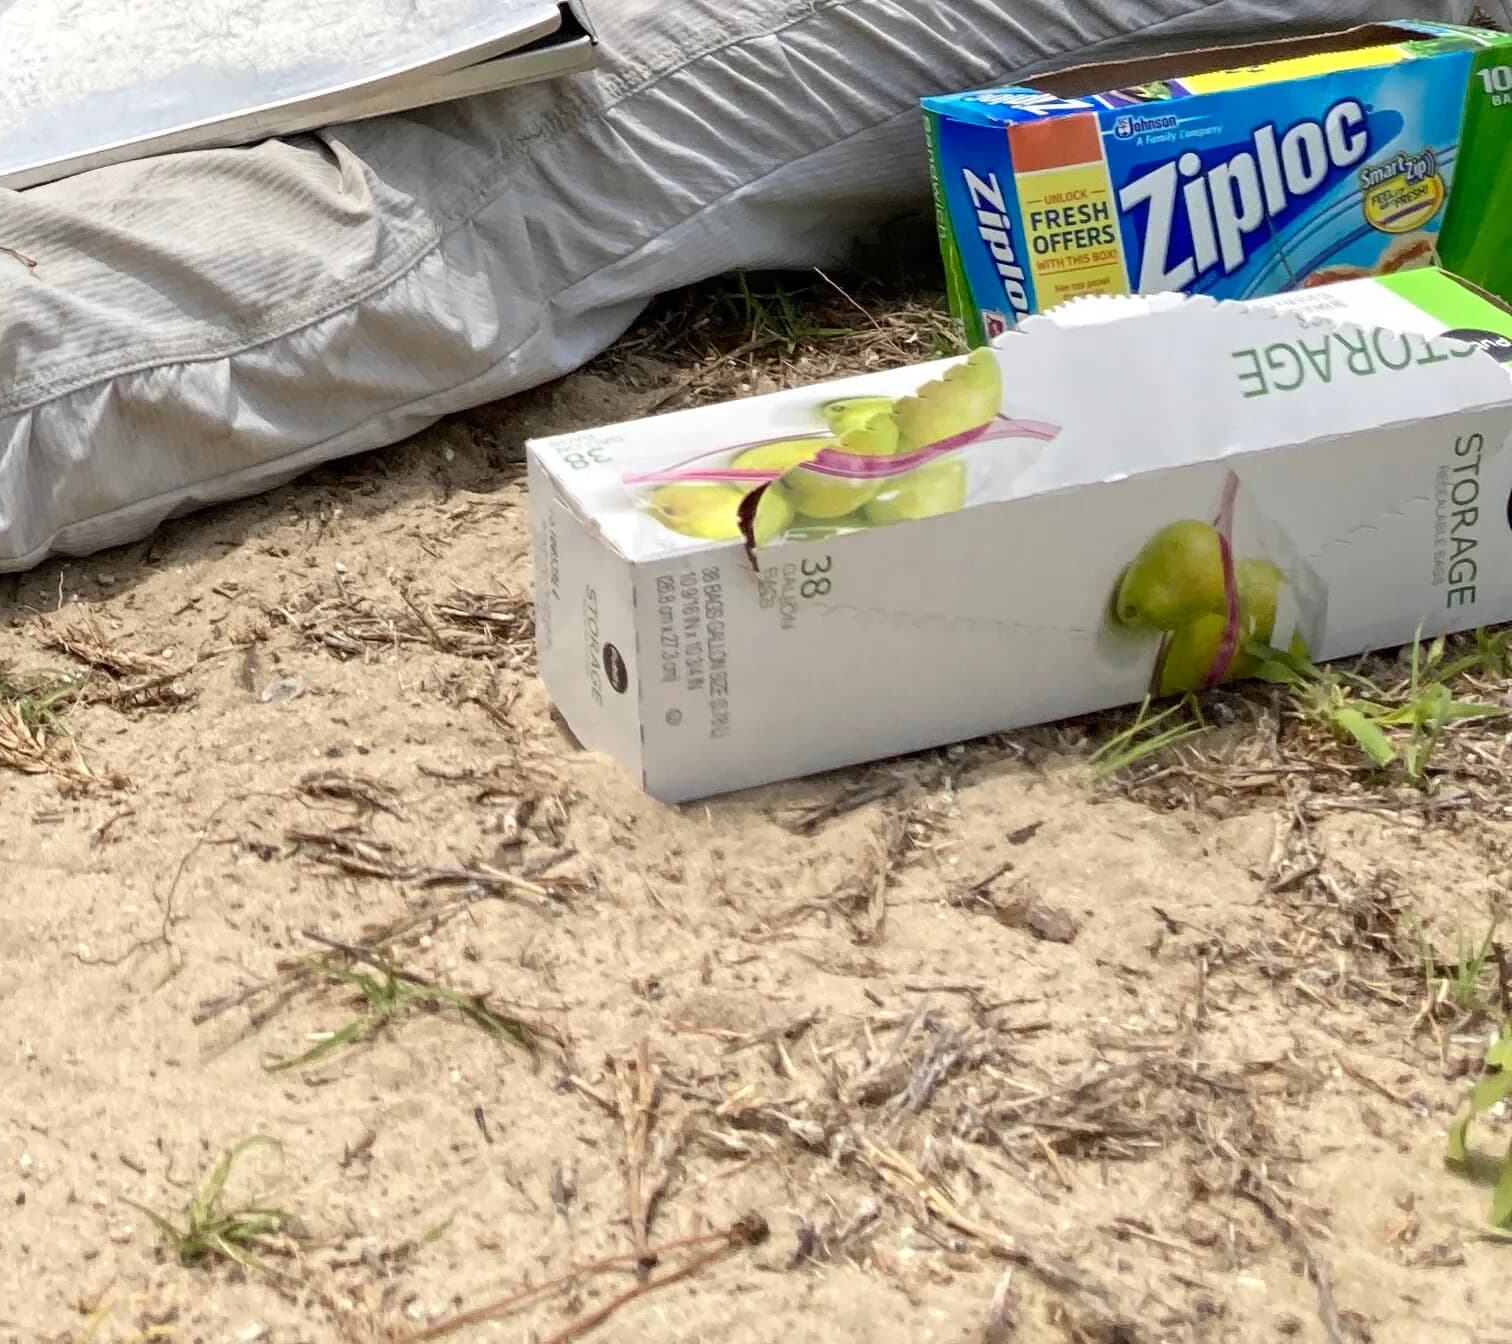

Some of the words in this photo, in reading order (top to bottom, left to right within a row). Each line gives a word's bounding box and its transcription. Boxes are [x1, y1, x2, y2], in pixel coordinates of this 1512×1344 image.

[1115, 116, 1176, 138] Johnson
[1146, 131, 1176, 144] Family
[1179, 125, 1223, 140] Company
[1044, 190, 1088, 205] UNLOCK
[1119, 99, 1369, 296] Ziploc
[1030, 201, 1110, 232] FRESH
[1032, 224, 1116, 255] OFFERS
[1037, 257, 1064, 271] WITH
[1066, 253, 1090, 267] THIS
[1092, 248, 1118, 263] BOX!
[564, 447, 613, 470] 38
[1446, 432, 1484, 609] STORAGE
[800, 555, 832, 599] 38
[703, 583, 724, 619] BAGS
[585, 583, 603, 708] STORAGE
[706, 621, 727, 669] GALLON
